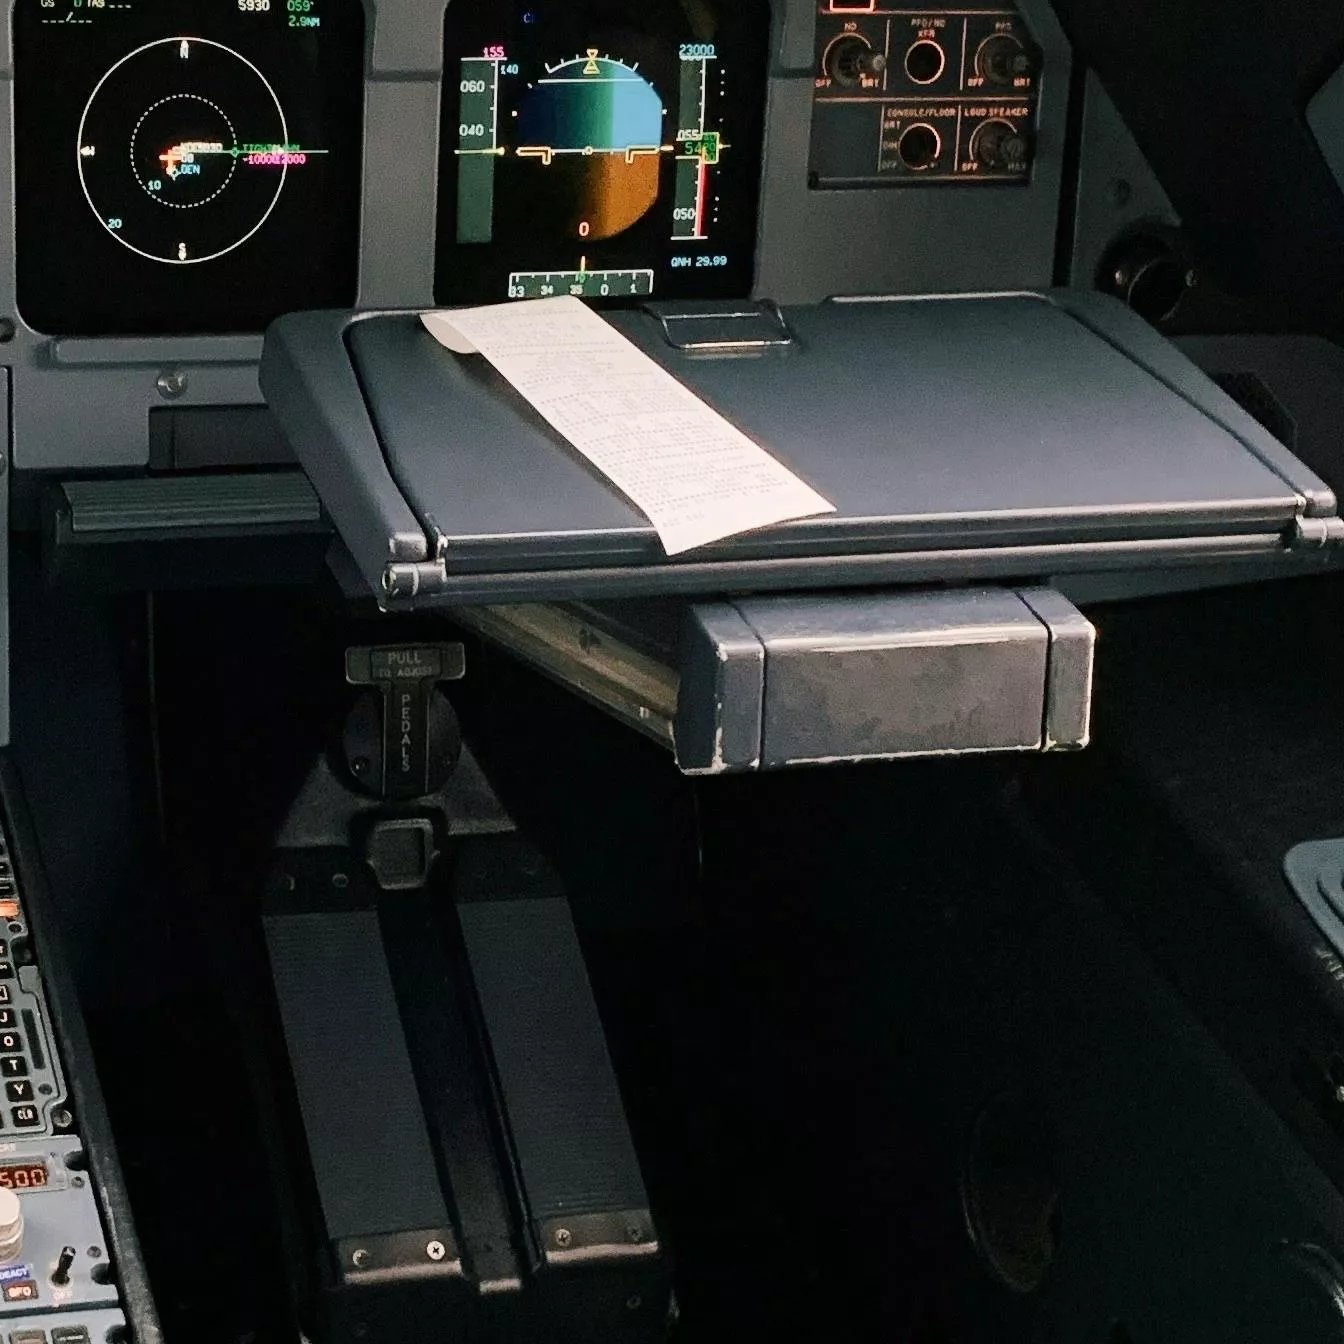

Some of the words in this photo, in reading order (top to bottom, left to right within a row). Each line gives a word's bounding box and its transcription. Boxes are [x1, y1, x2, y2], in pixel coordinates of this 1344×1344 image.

[679, 44, 714, 56] 23000
[460, 81, 485, 92] 060
[459, 125, 484, 136] 040
[671, 258, 691, 267] QNH
[696, 257, 727, 266] 29.99
[388, 653, 421, 664] PULL
[401, 694, 410, 772] PEDALS
